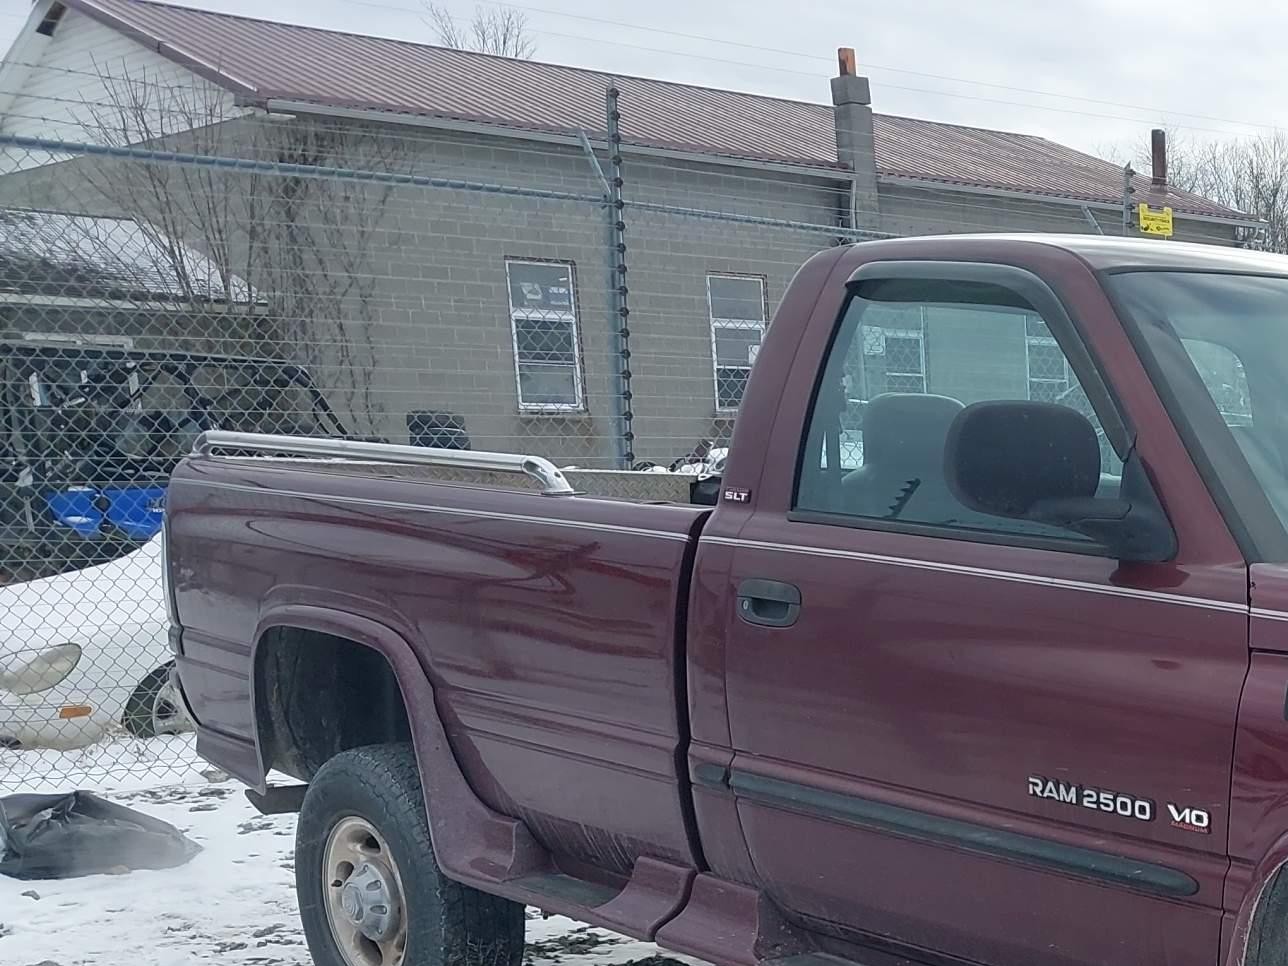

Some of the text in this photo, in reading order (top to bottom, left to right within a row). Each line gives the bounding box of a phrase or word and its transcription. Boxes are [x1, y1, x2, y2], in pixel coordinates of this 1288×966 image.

[724, 490, 749, 502] SLT
[1028, 776, 1209, 828] RAM 2500 V10
